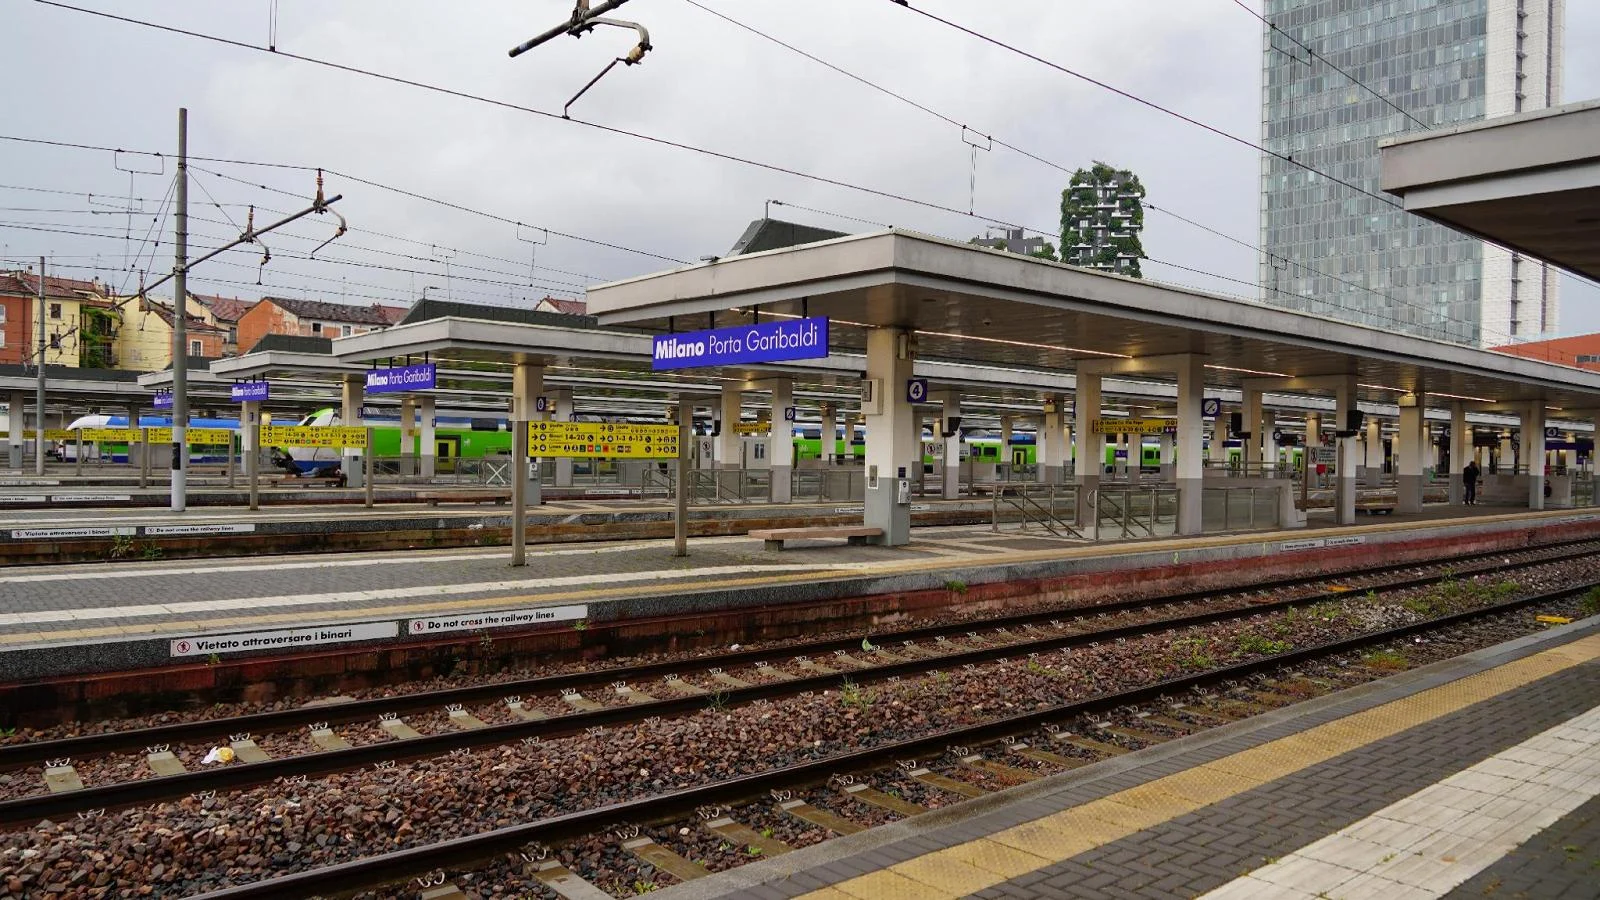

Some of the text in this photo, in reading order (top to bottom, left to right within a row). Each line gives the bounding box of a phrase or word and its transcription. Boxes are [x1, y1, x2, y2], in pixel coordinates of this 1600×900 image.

[655, 322, 818, 360] Milano Porta Garibaldi
[367, 367, 432, 386] Milano Porta Garibaldi
[428, 611, 555, 629] Do not cross the railway lines
[196, 629, 352, 650] Vietato attraversare i binari
